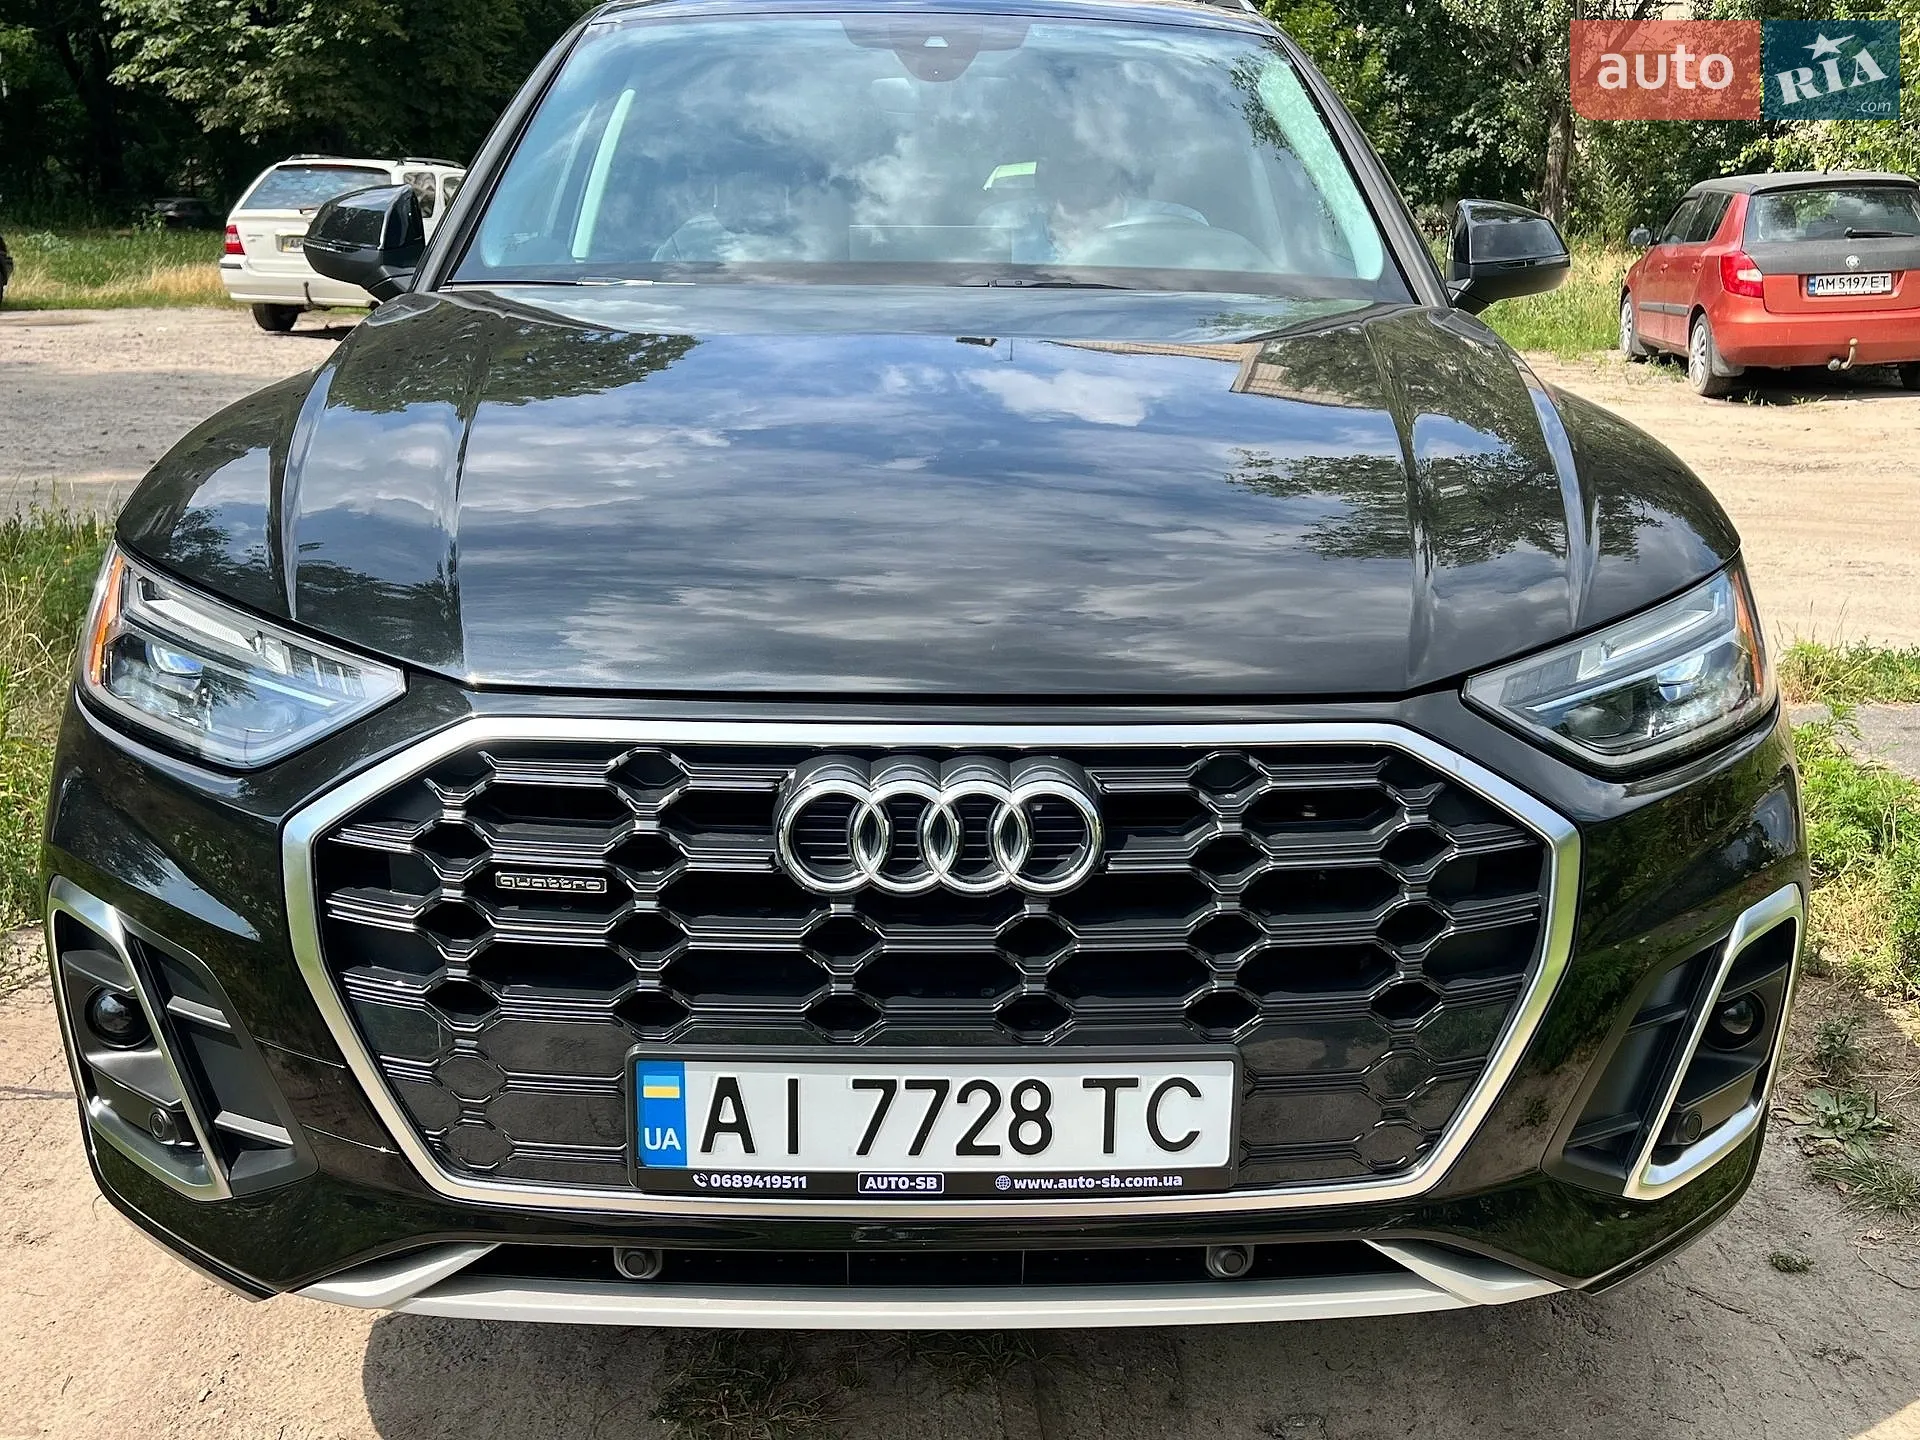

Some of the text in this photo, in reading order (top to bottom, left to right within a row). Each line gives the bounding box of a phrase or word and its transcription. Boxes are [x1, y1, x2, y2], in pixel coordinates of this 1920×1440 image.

[1817, 276, 1888, 290] AM 5197 ET
[500, 876, 601, 890] quattro
[700, 1076, 1203, 1156] AI 7728 TC
[644, 1128, 682, 1151] UA
[710, 1174, 807, 1189] 0689419511
[865, 1176, 937, 1190] AUTO-SB
[1014, 1174, 1183, 1189] www.auto-sb.com.ua
